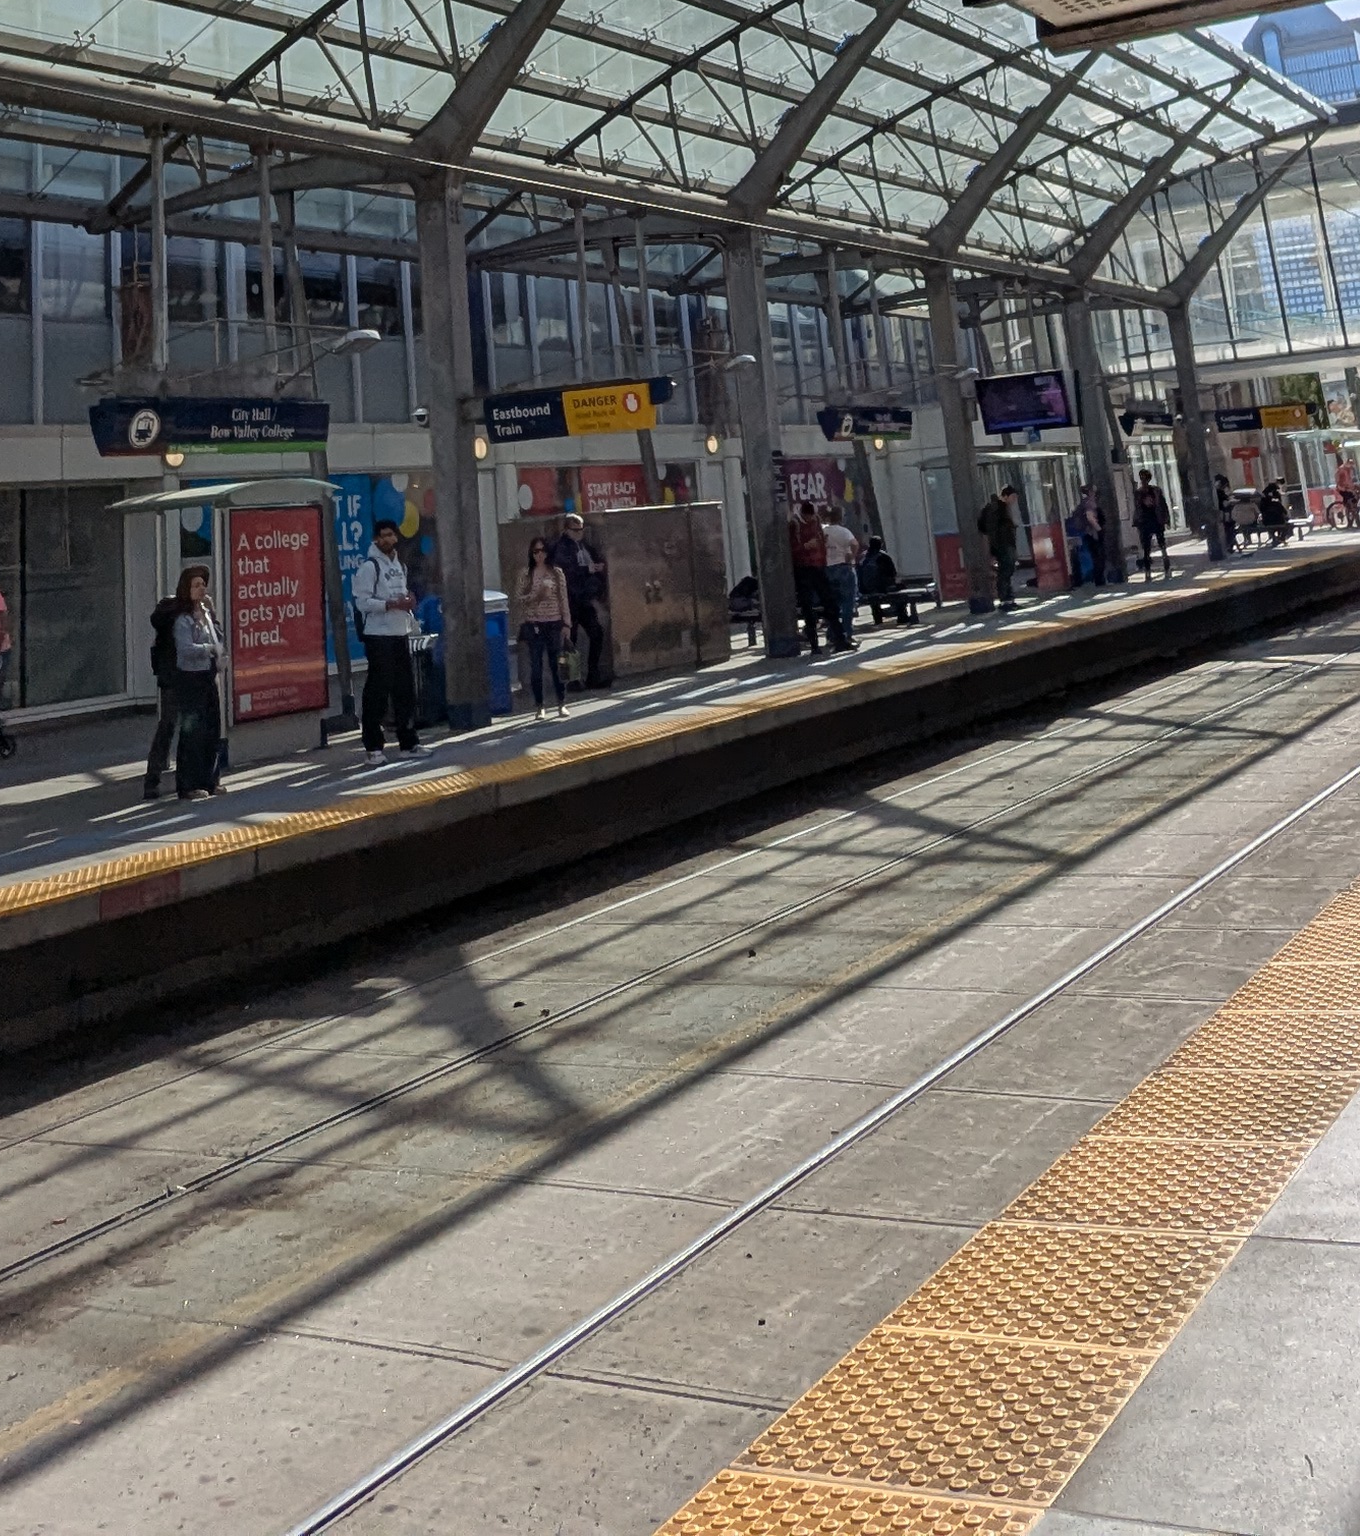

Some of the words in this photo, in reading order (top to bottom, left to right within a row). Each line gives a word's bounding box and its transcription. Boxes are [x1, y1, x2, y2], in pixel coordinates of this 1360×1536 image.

[492, 402, 552, 421] Eastbound
[572, 394, 618, 409] DANGER
[494, 424, 523, 438] Train
[587, 482, 612, 498] START
[613, 481, 636, 495] EACH
[790, 472, 828, 501] FEAR
[237, 533, 251, 551] A
[255, 530, 309, 552] college
[238, 555, 270, 576] that
[238, 577, 299, 600] actually
[239, 603, 274, 627] gets
[277, 602, 305, 624] you
[239, 625, 283, 649] hired.
